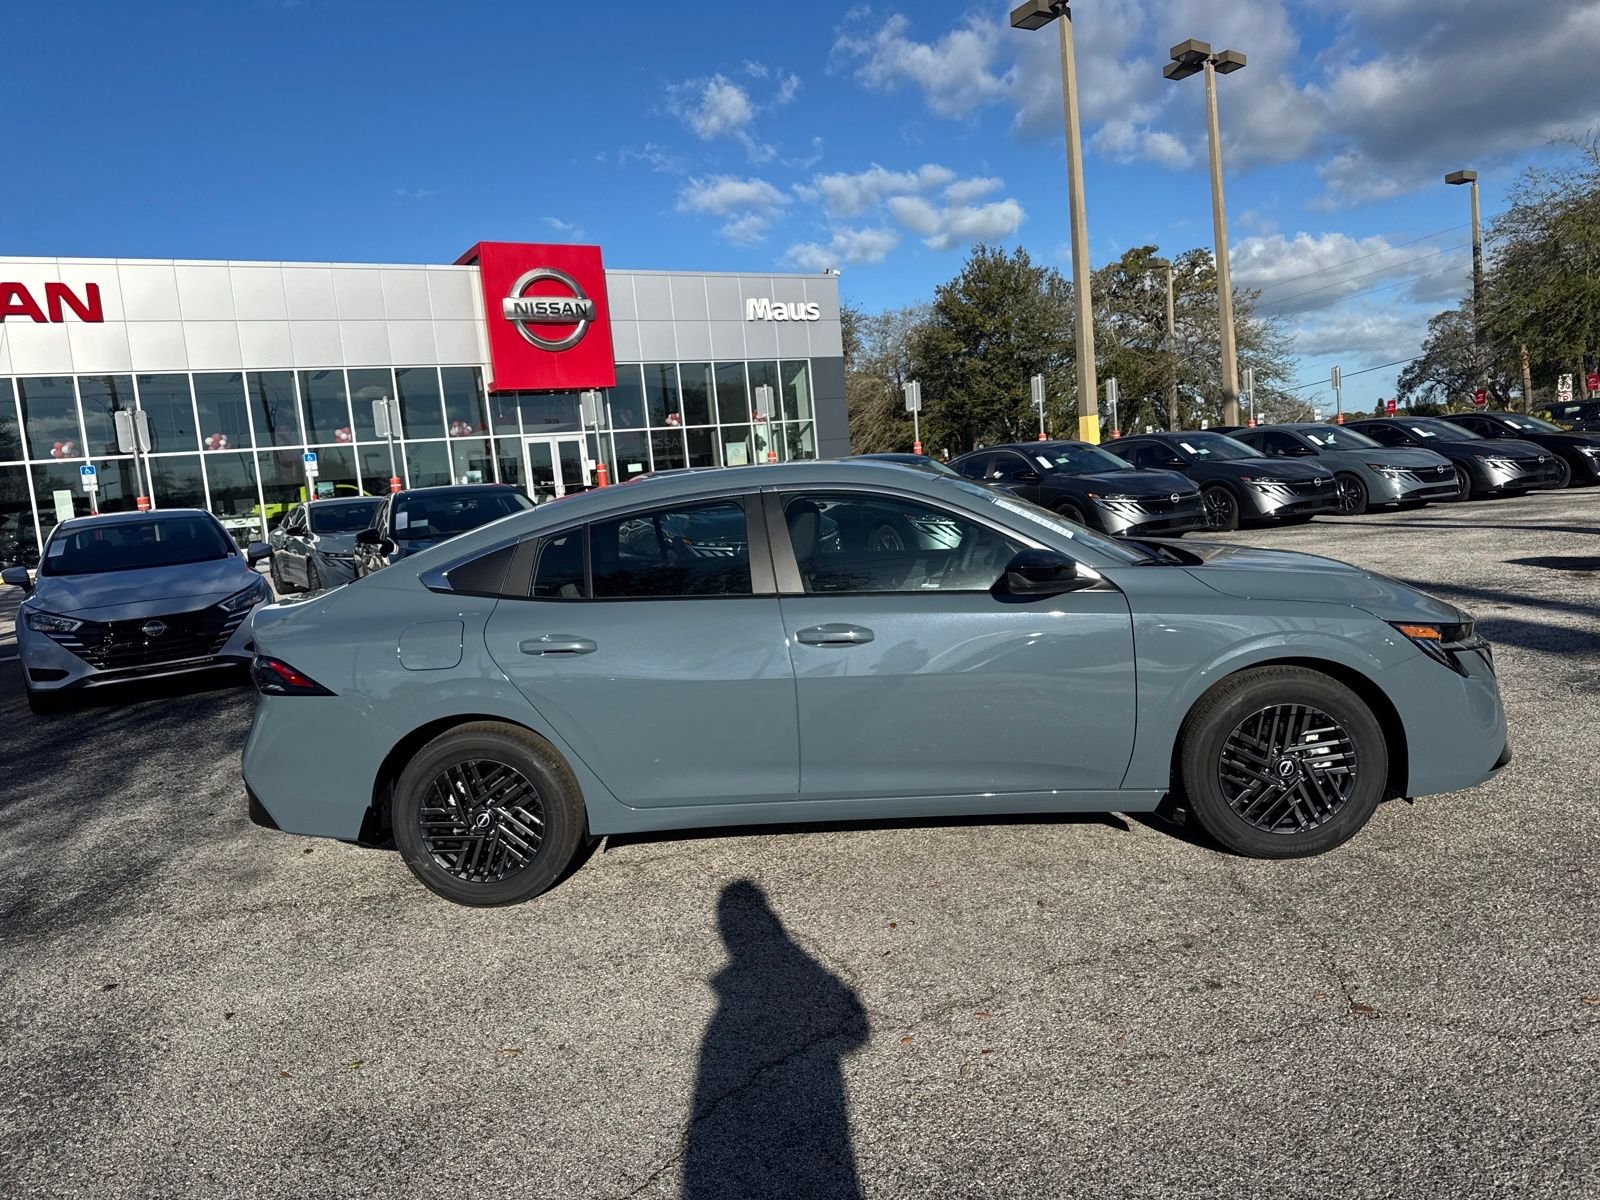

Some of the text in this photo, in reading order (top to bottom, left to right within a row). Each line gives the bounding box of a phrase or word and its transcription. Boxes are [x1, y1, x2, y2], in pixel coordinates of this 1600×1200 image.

[0, 282, 104, 323] AN
[513, 302, 588, 315] NISSAN
[746, 298, 820, 322] Maus
